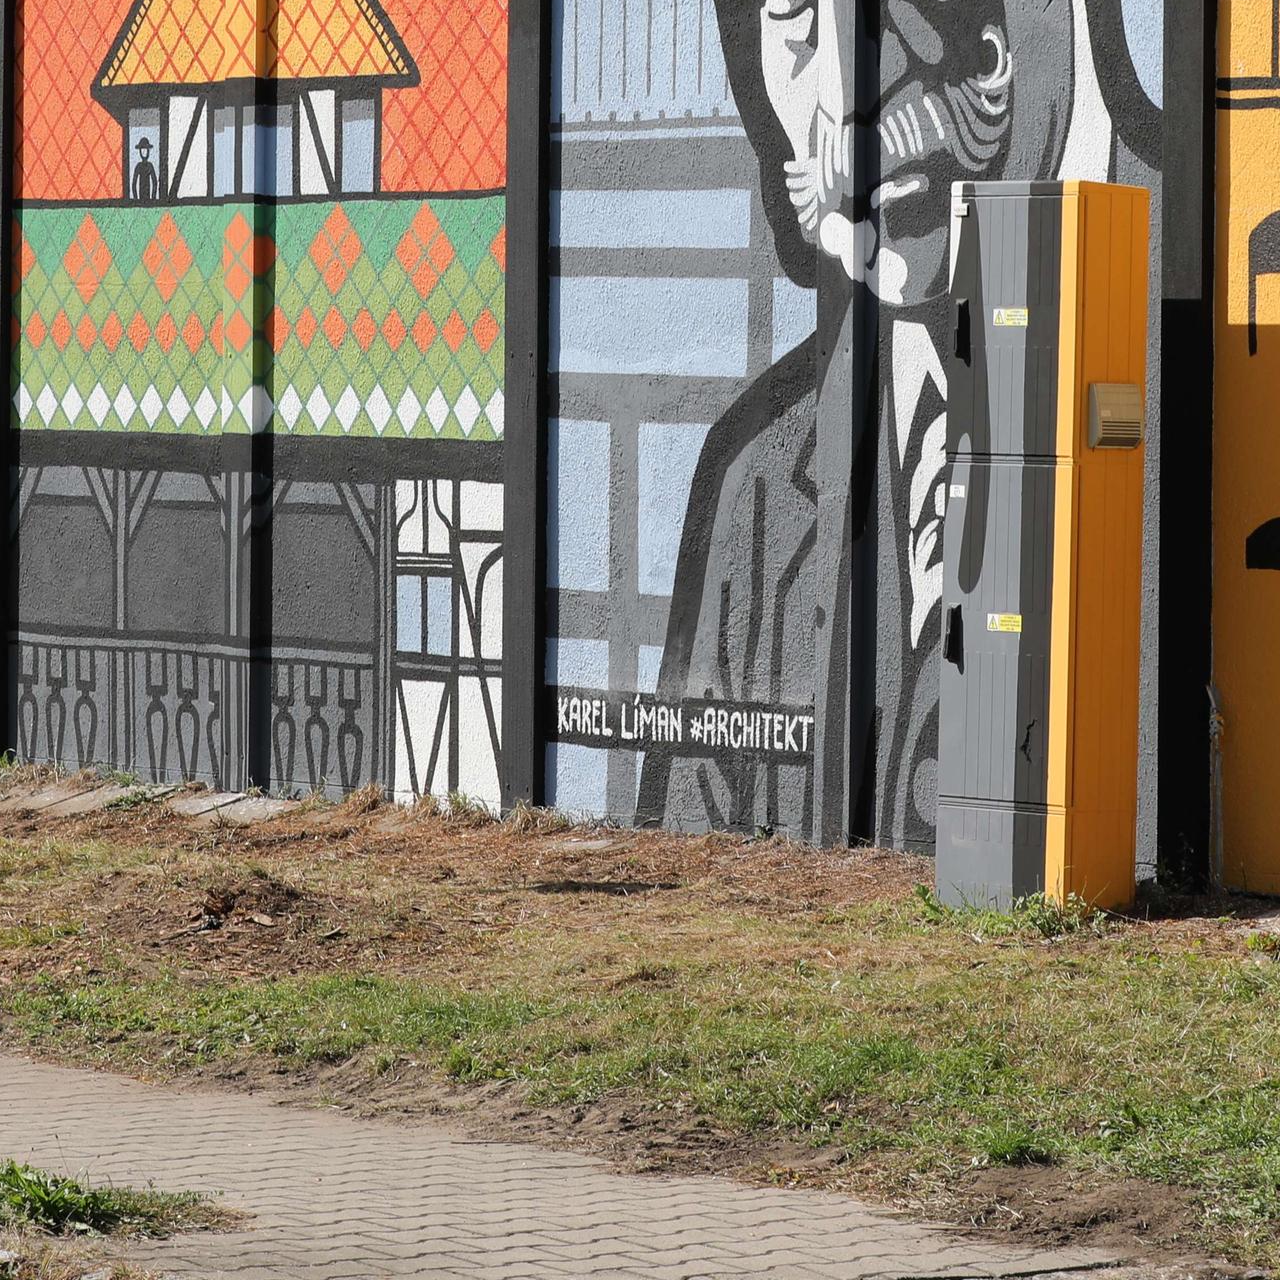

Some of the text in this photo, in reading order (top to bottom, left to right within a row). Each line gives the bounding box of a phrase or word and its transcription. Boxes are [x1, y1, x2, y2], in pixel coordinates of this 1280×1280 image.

[557, 694, 814, 752] KAREL LÍMAN #ARCHITEKT
